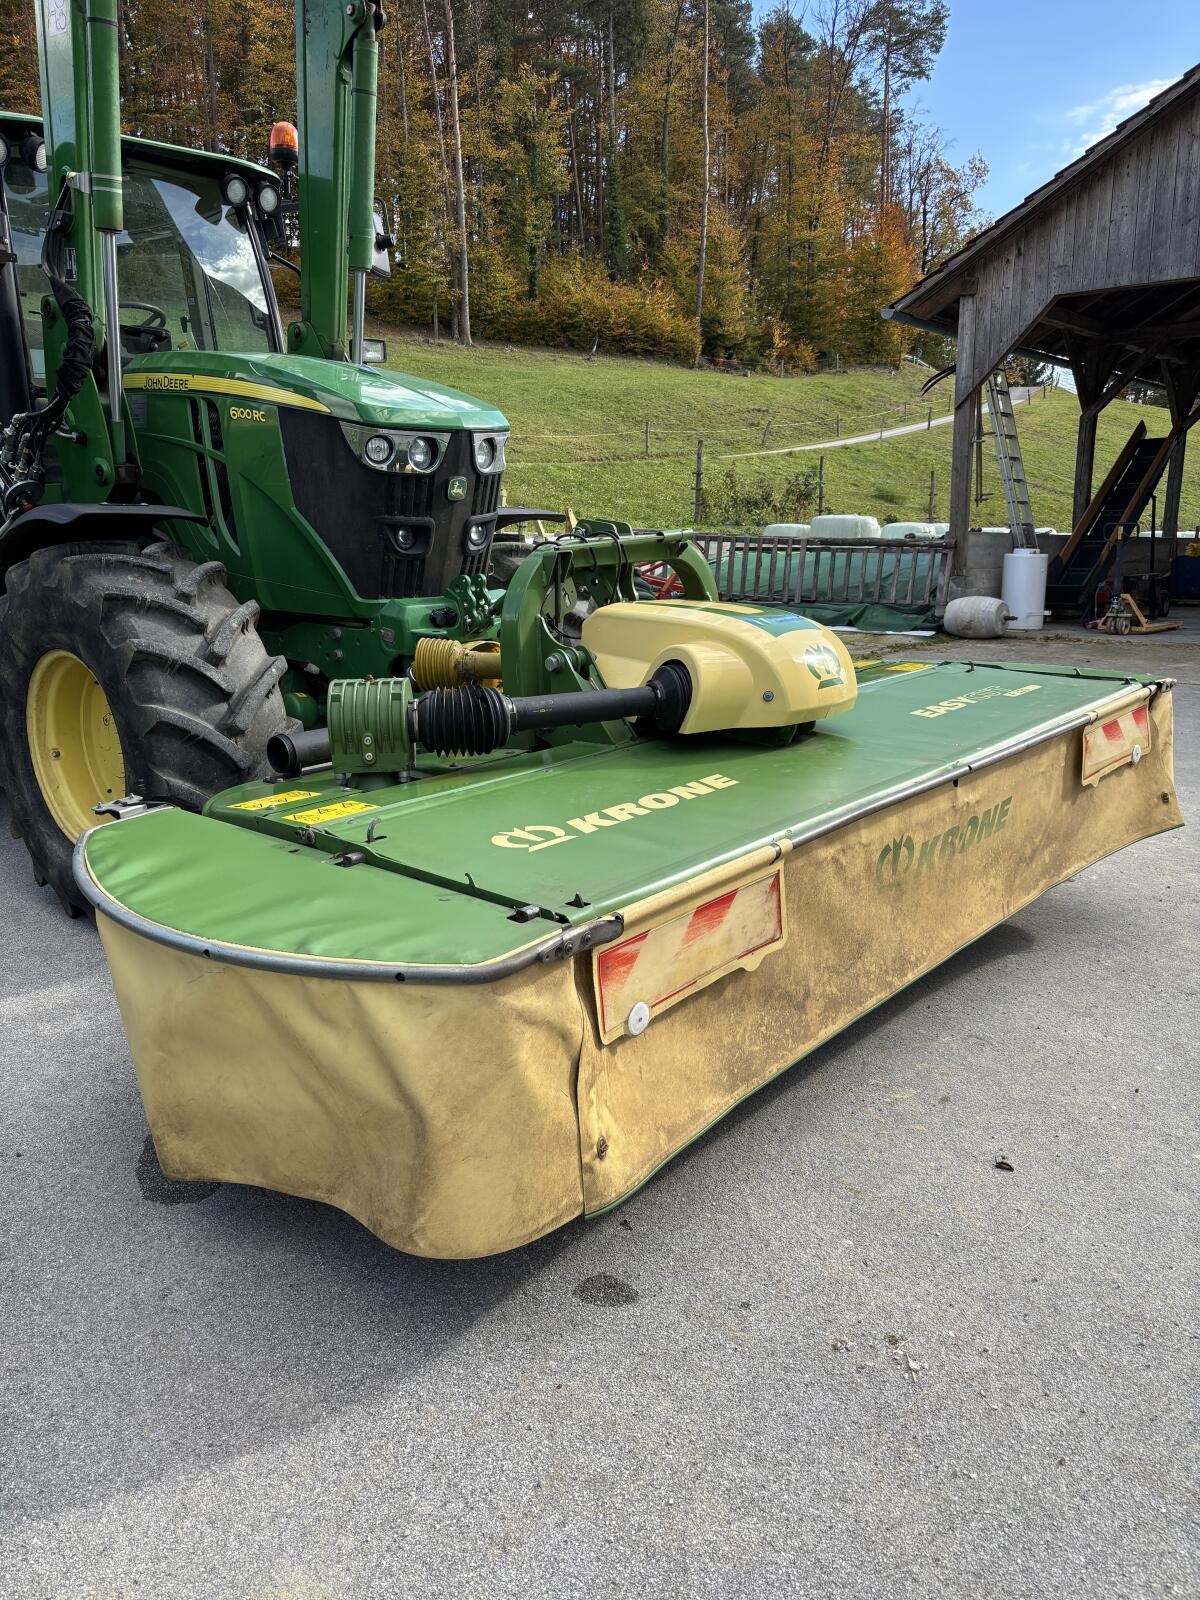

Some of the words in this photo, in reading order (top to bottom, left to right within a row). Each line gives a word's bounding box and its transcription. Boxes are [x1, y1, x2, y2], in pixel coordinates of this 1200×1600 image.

[143, 376, 163, 389] JOHN
[163, 376, 189, 390] DEERE
[230, 406, 252, 419] 6100
[253, 409, 266, 422] RC
[566, 773, 740, 834] KRONE
[914, 796, 1013, 876] KRONE
